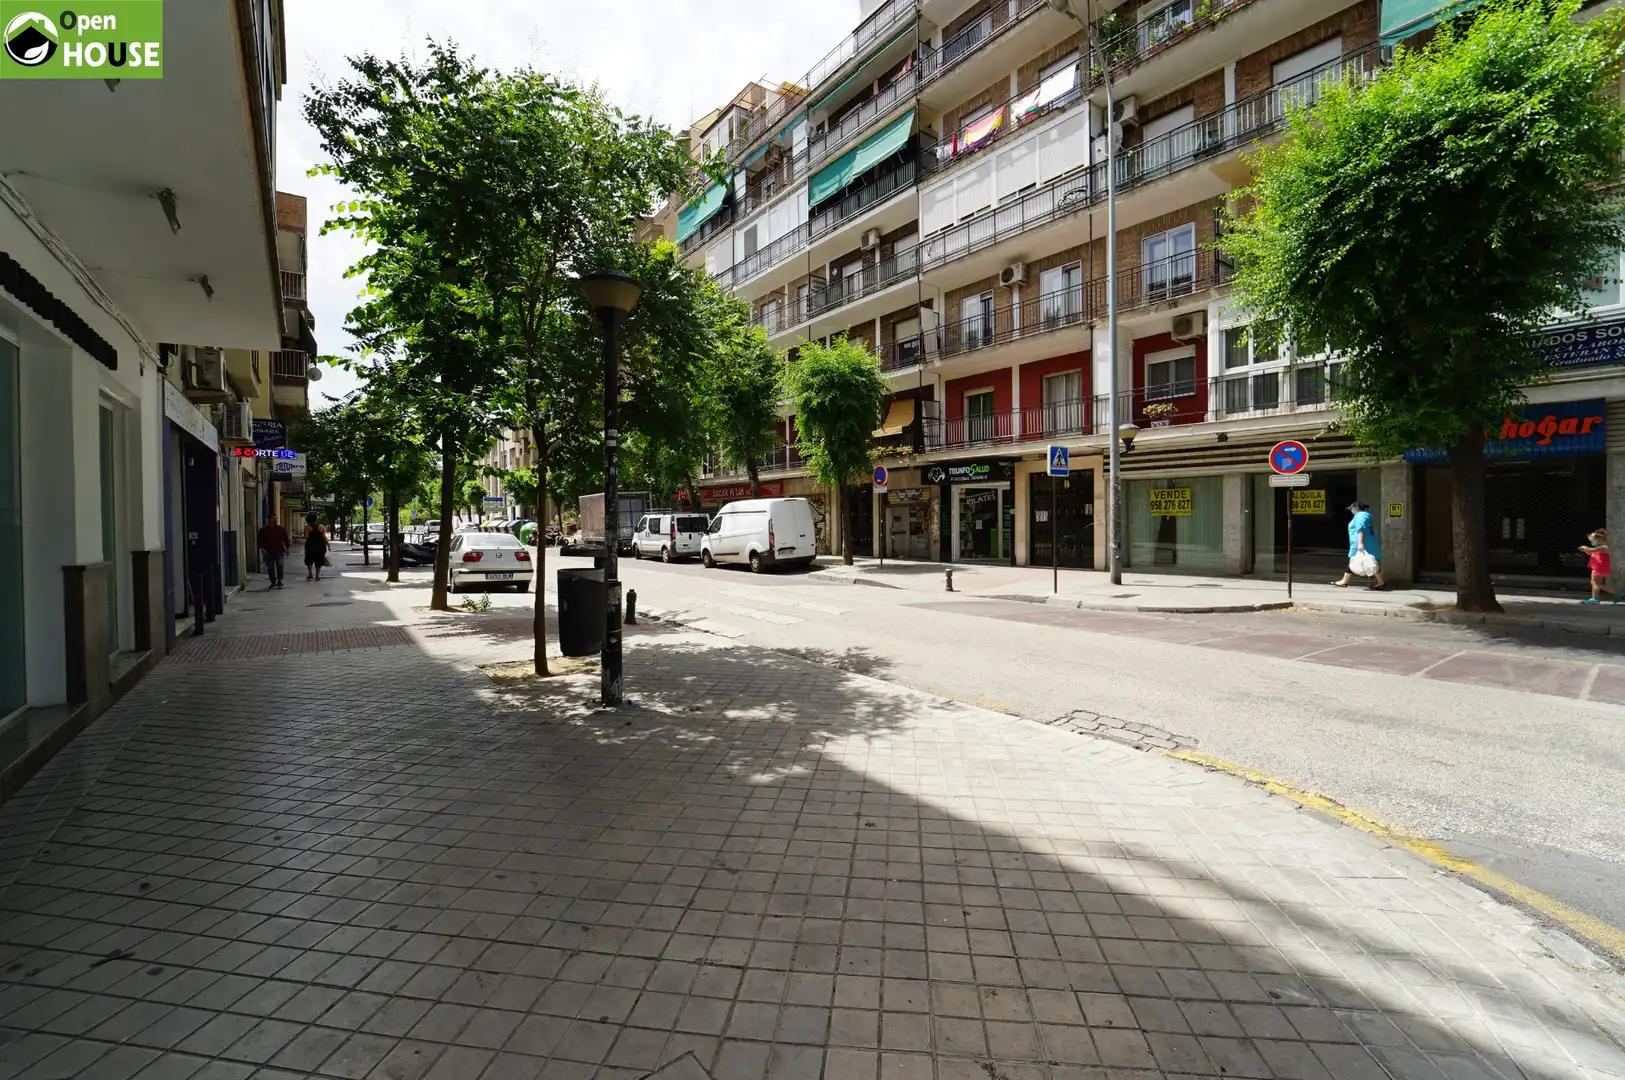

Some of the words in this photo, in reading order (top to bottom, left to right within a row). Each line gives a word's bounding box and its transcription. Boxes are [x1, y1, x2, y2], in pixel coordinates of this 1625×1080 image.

[1595, 326, 1625, 340] SO
[1549, 356, 1610, 367] Graduado
[1499, 408, 1603, 445] hogar
[244, 448, 279, 458] CORTE
[281, 450, 293, 458] DE
[275, 462, 304, 471] TRIUNFO
[966, 493, 996, 505] PILATES
[1154, 490, 1187, 499] VENDE
[1292, 492, 1322, 500] ALQUILA
[1150, 500, 1162, 510] 958
[1163, 499, 1176, 510] 276
[1177, 499, 1190, 510] 827
[1300, 500, 1312, 509] 276
[1312, 500, 1325, 509] 827
